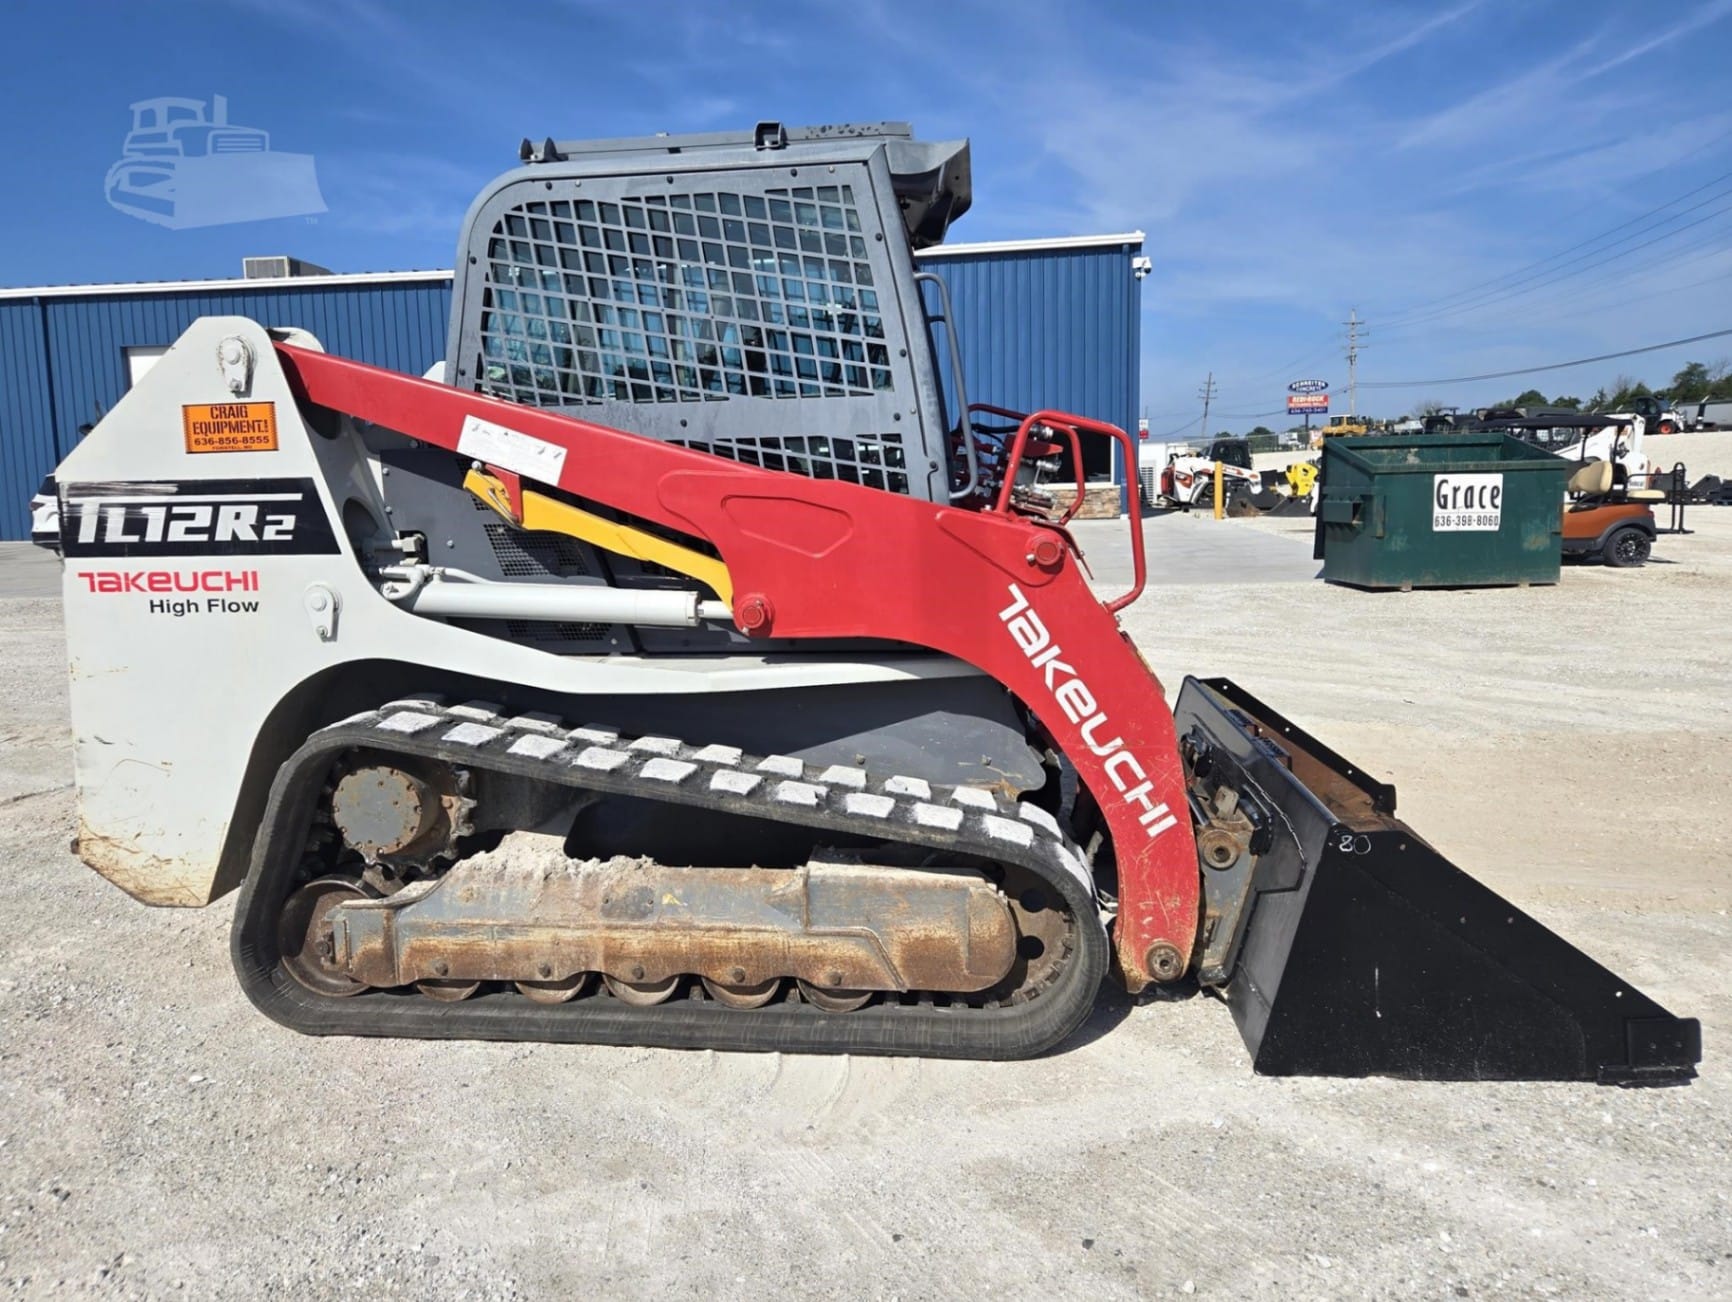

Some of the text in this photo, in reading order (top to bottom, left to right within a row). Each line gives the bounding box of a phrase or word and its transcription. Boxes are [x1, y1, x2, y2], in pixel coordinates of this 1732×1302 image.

[210, 405, 248, 420] CRAIG
[194, 435, 270, 446] 636-856-8555
[1436, 479, 1501, 510] Grace
[1434, 514, 1499, 527] 636-398-8060
[150, 599, 260, 617] High Flow
[1338, 834, 1372, 856] 80
